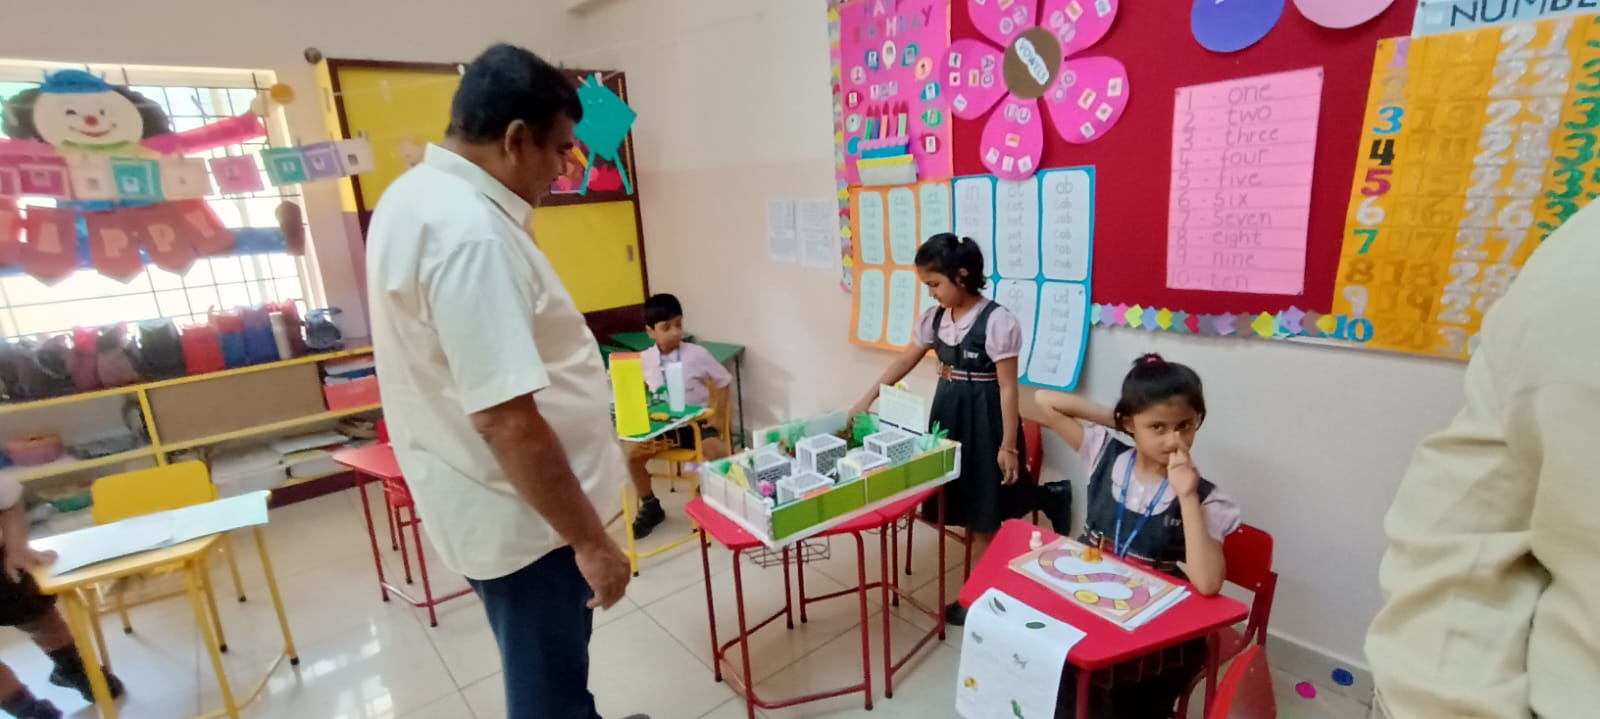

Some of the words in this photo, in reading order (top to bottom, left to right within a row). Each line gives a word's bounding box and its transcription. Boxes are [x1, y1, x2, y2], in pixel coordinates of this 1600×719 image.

[1228, 83, 1272, 105] one
[1225, 104, 1272, 126] two
[1372, 106, 1405, 135] 3
[1224, 127, 1279, 146] three
[1219, 147, 1270, 169] four
[1369, 139, 1395, 166] 4
[1218, 168, 1263, 189] five
[1361, 168, 1393, 196] 5
[1357, 196, 1385, 226] 6
[1212, 229, 1262, 248] eight
[1353, 229, 1379, 255] 7
[1212, 251, 1255, 267] nine
[1345, 258, 1375, 284] 8
[1210, 271, 1249, 289] ten
[1343, 285, 1369, 319] 9
[1332, 315, 1374, 342] 10
